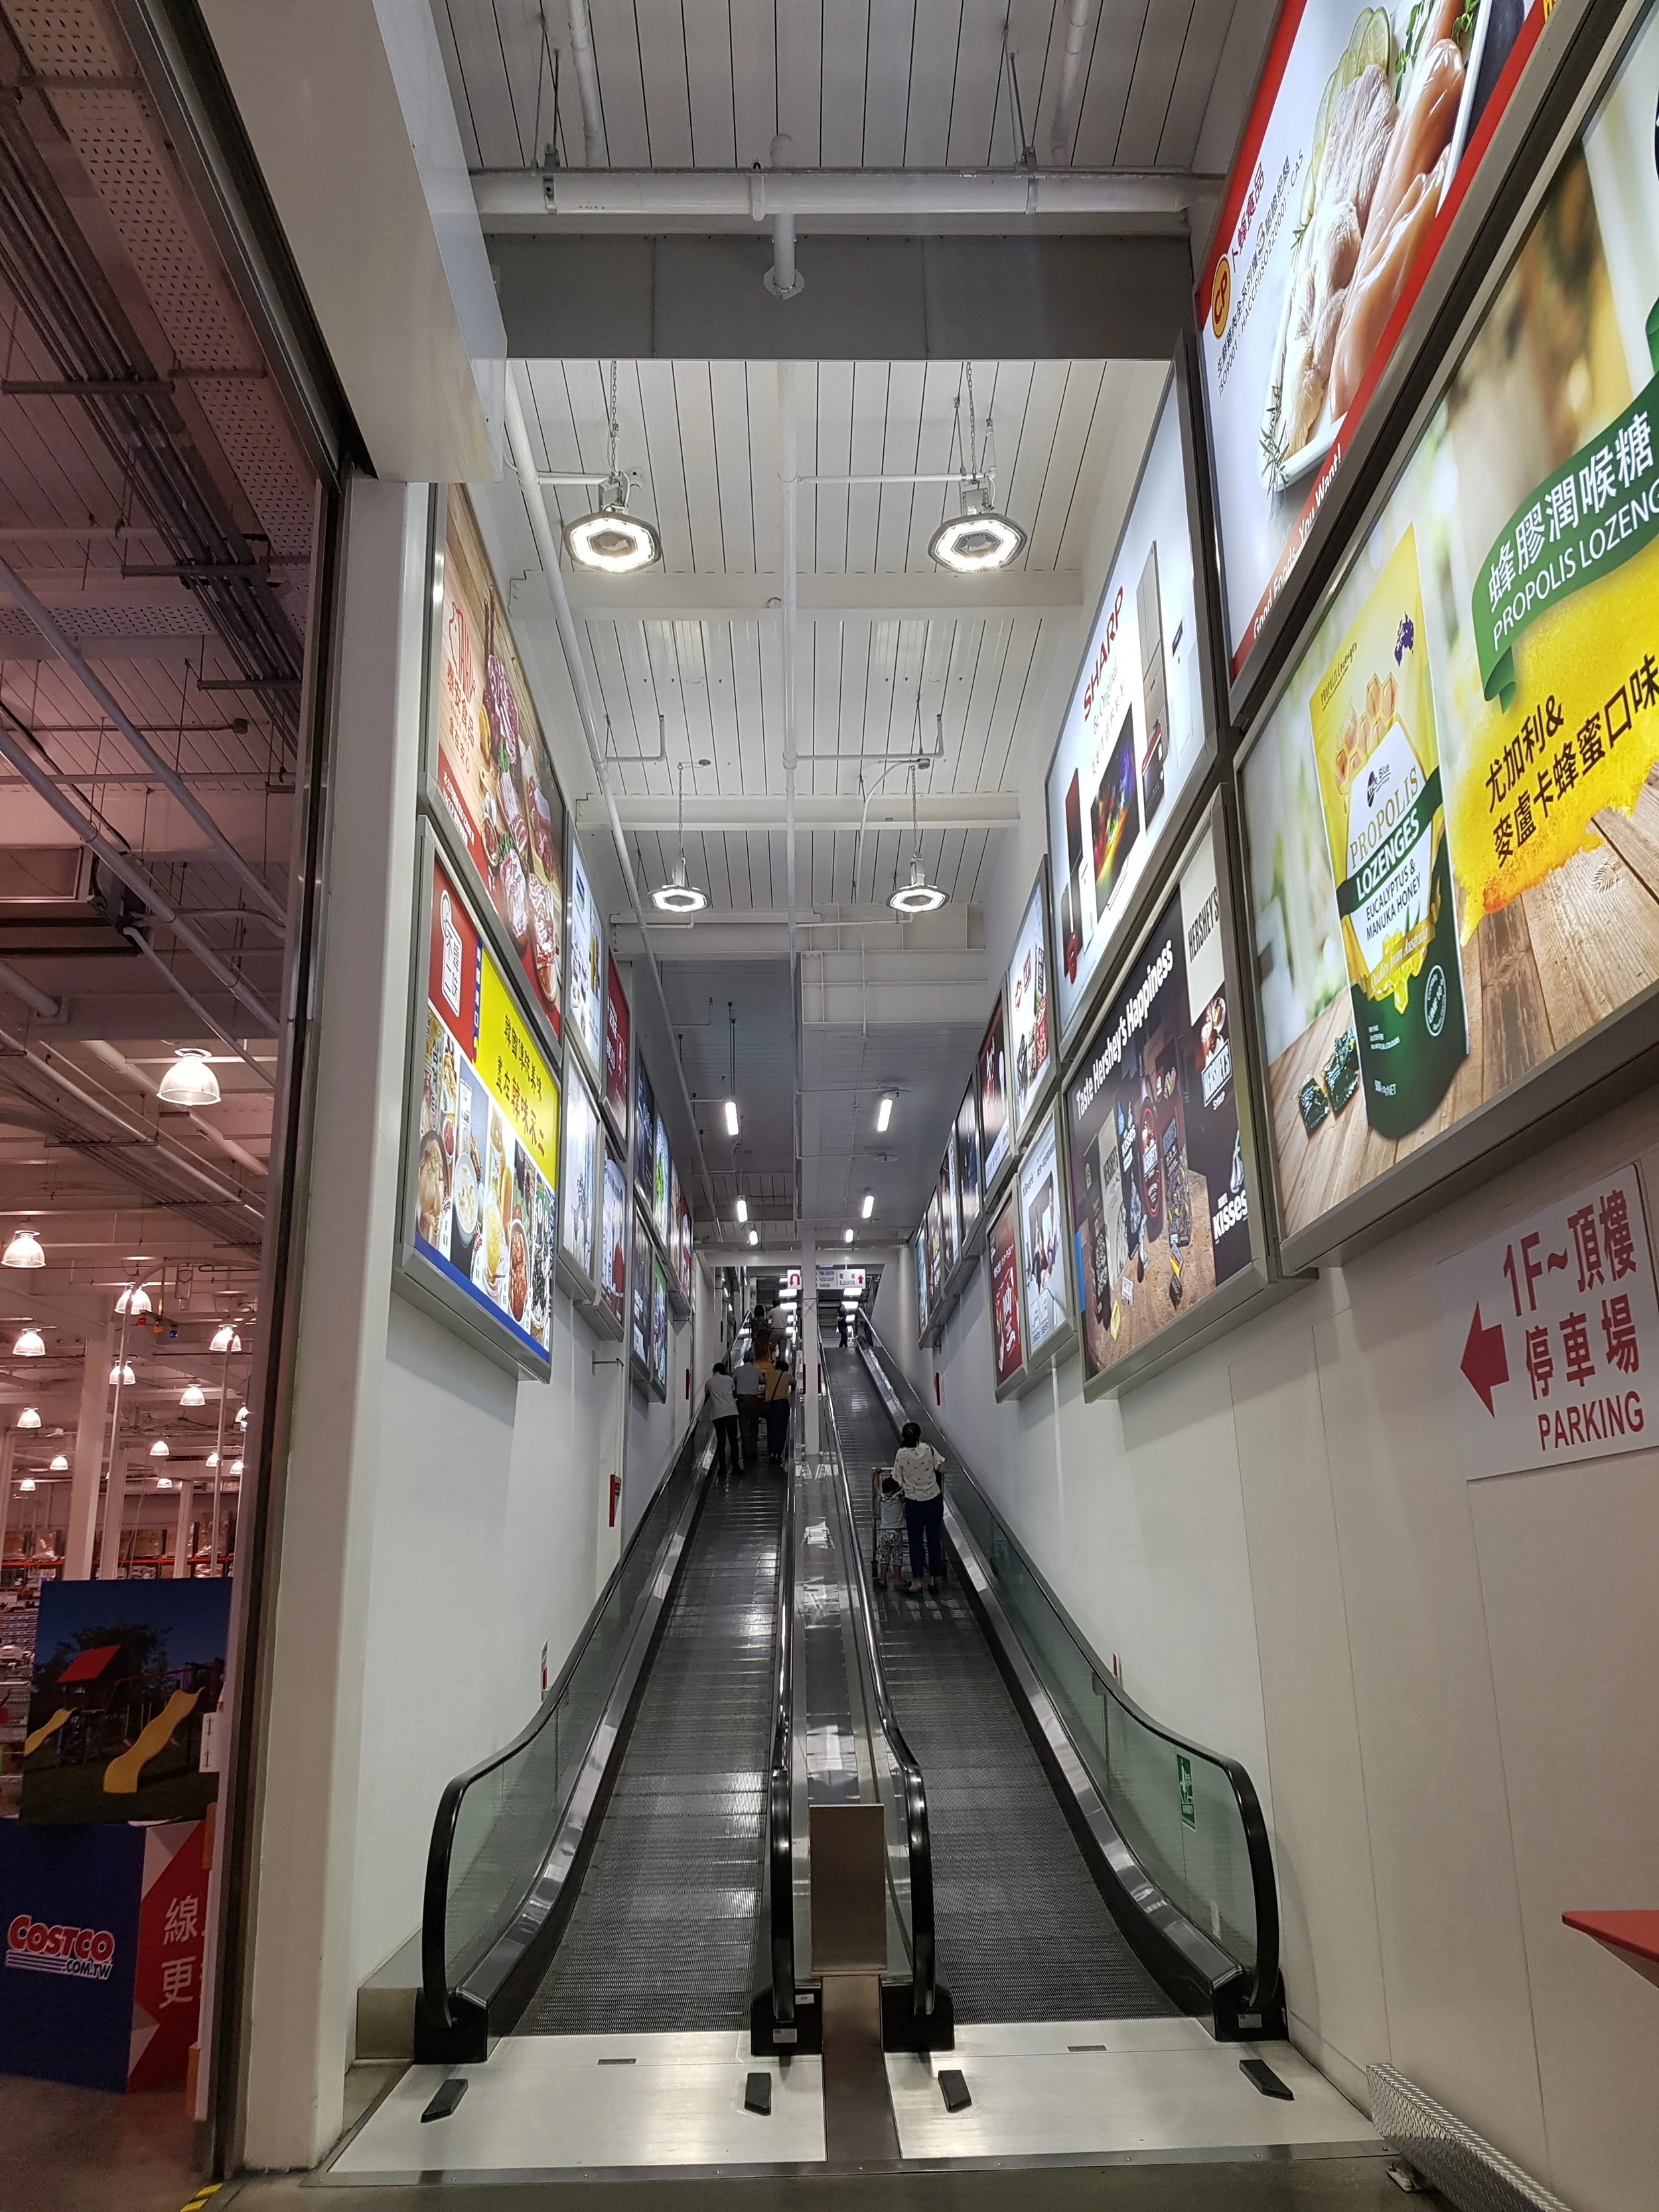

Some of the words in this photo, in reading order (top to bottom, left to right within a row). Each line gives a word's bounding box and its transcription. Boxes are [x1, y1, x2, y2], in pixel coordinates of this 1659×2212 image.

[1291, 149, 1303, 188] CAS
[1232, 163, 1265, 273] 卜蜂食品
[1214, 271, 1228, 326] CP
[1298, 506, 1315, 543] You
[1315, 443, 1341, 508] Want!
[1488, 411, 1654, 613] 蜂膠潤喉糖
[1493, 548, 1576, 651] PROPOLIS
[1084, 585, 1123, 722] SHARP
[1485, 695, 1565, 814] 尤加利&
[1492, 653, 1659, 868] 麥盧卡蜂蜜口味
[1350, 767, 1419, 869] PROPOLIS
[1356, 808, 1419, 901] LOZENGES
[1187, 886, 1220, 964] HERSHEY'S
[1366, 867, 1409, 921] EUCALYPTUS
[1409, 859, 1415, 875] &
[1366, 907, 1396, 941] MANUKA
[1396, 871, 1421, 912] HONEY
[1076, 1080, 1094, 1120] Taste
[1093, 1015, 1127, 1095] Hershey's
[1125, 940, 1173, 1037] Happiness
[1204, 1049, 1230, 1100] HERSHEY'S
[1503, 1189, 1636, 1317] 1F~頂樓
[1526, 1293, 1640, 1400] 停車場
[1538, 1390, 1644, 1451] PARKING
[7, 1914, 115, 1961] COSTCO
[163, 1895, 204, 1945] 線
[159, 1956, 203, 2010] 更
